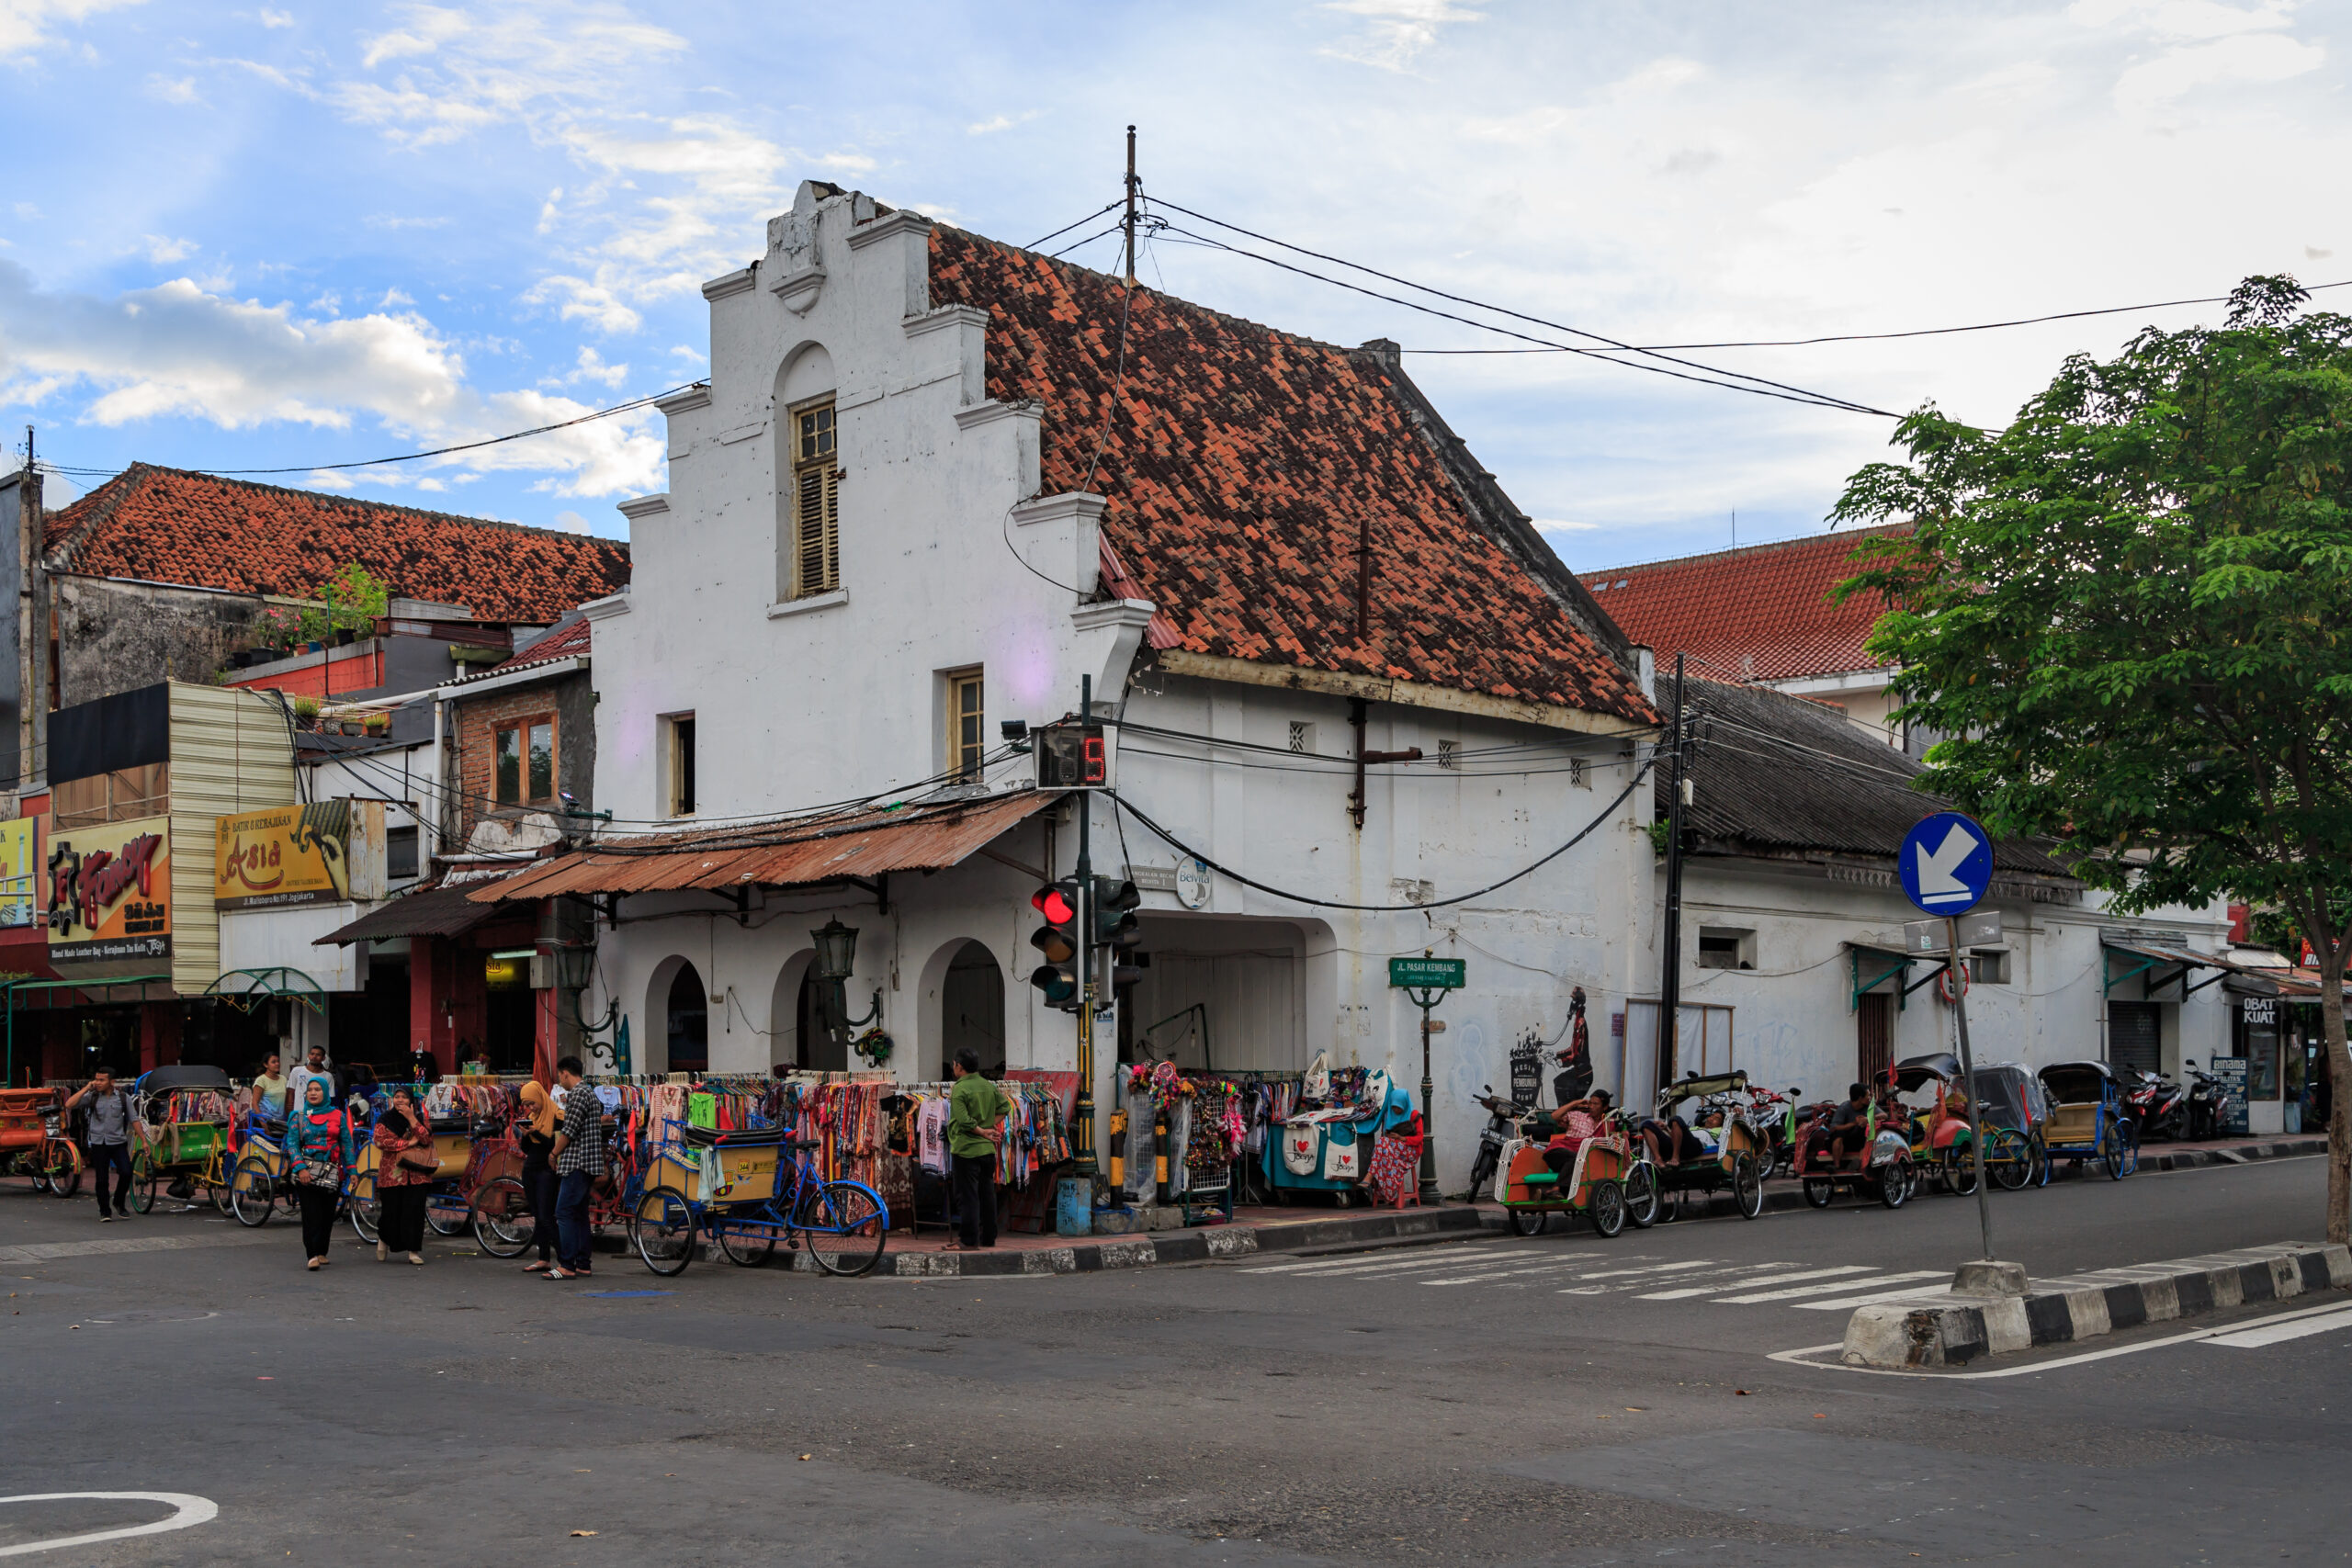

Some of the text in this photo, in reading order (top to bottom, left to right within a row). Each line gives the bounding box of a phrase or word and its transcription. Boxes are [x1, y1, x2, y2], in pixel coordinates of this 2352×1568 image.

[232, 820, 250, 832] BATIK
[1130, 870, 1158, 878] ANGKALAN
[288, 892, 314, 903] Jogjakarta
[93, 946, 101, 957] Bag
[126, 944, 134, 953] Tas
[1396, 962, 1456, 973] JL. PASAR KEMBANG
[2244, 998, 2276, 1010] OBAT
[2244, 1010, 2276, 1024] KUAT
